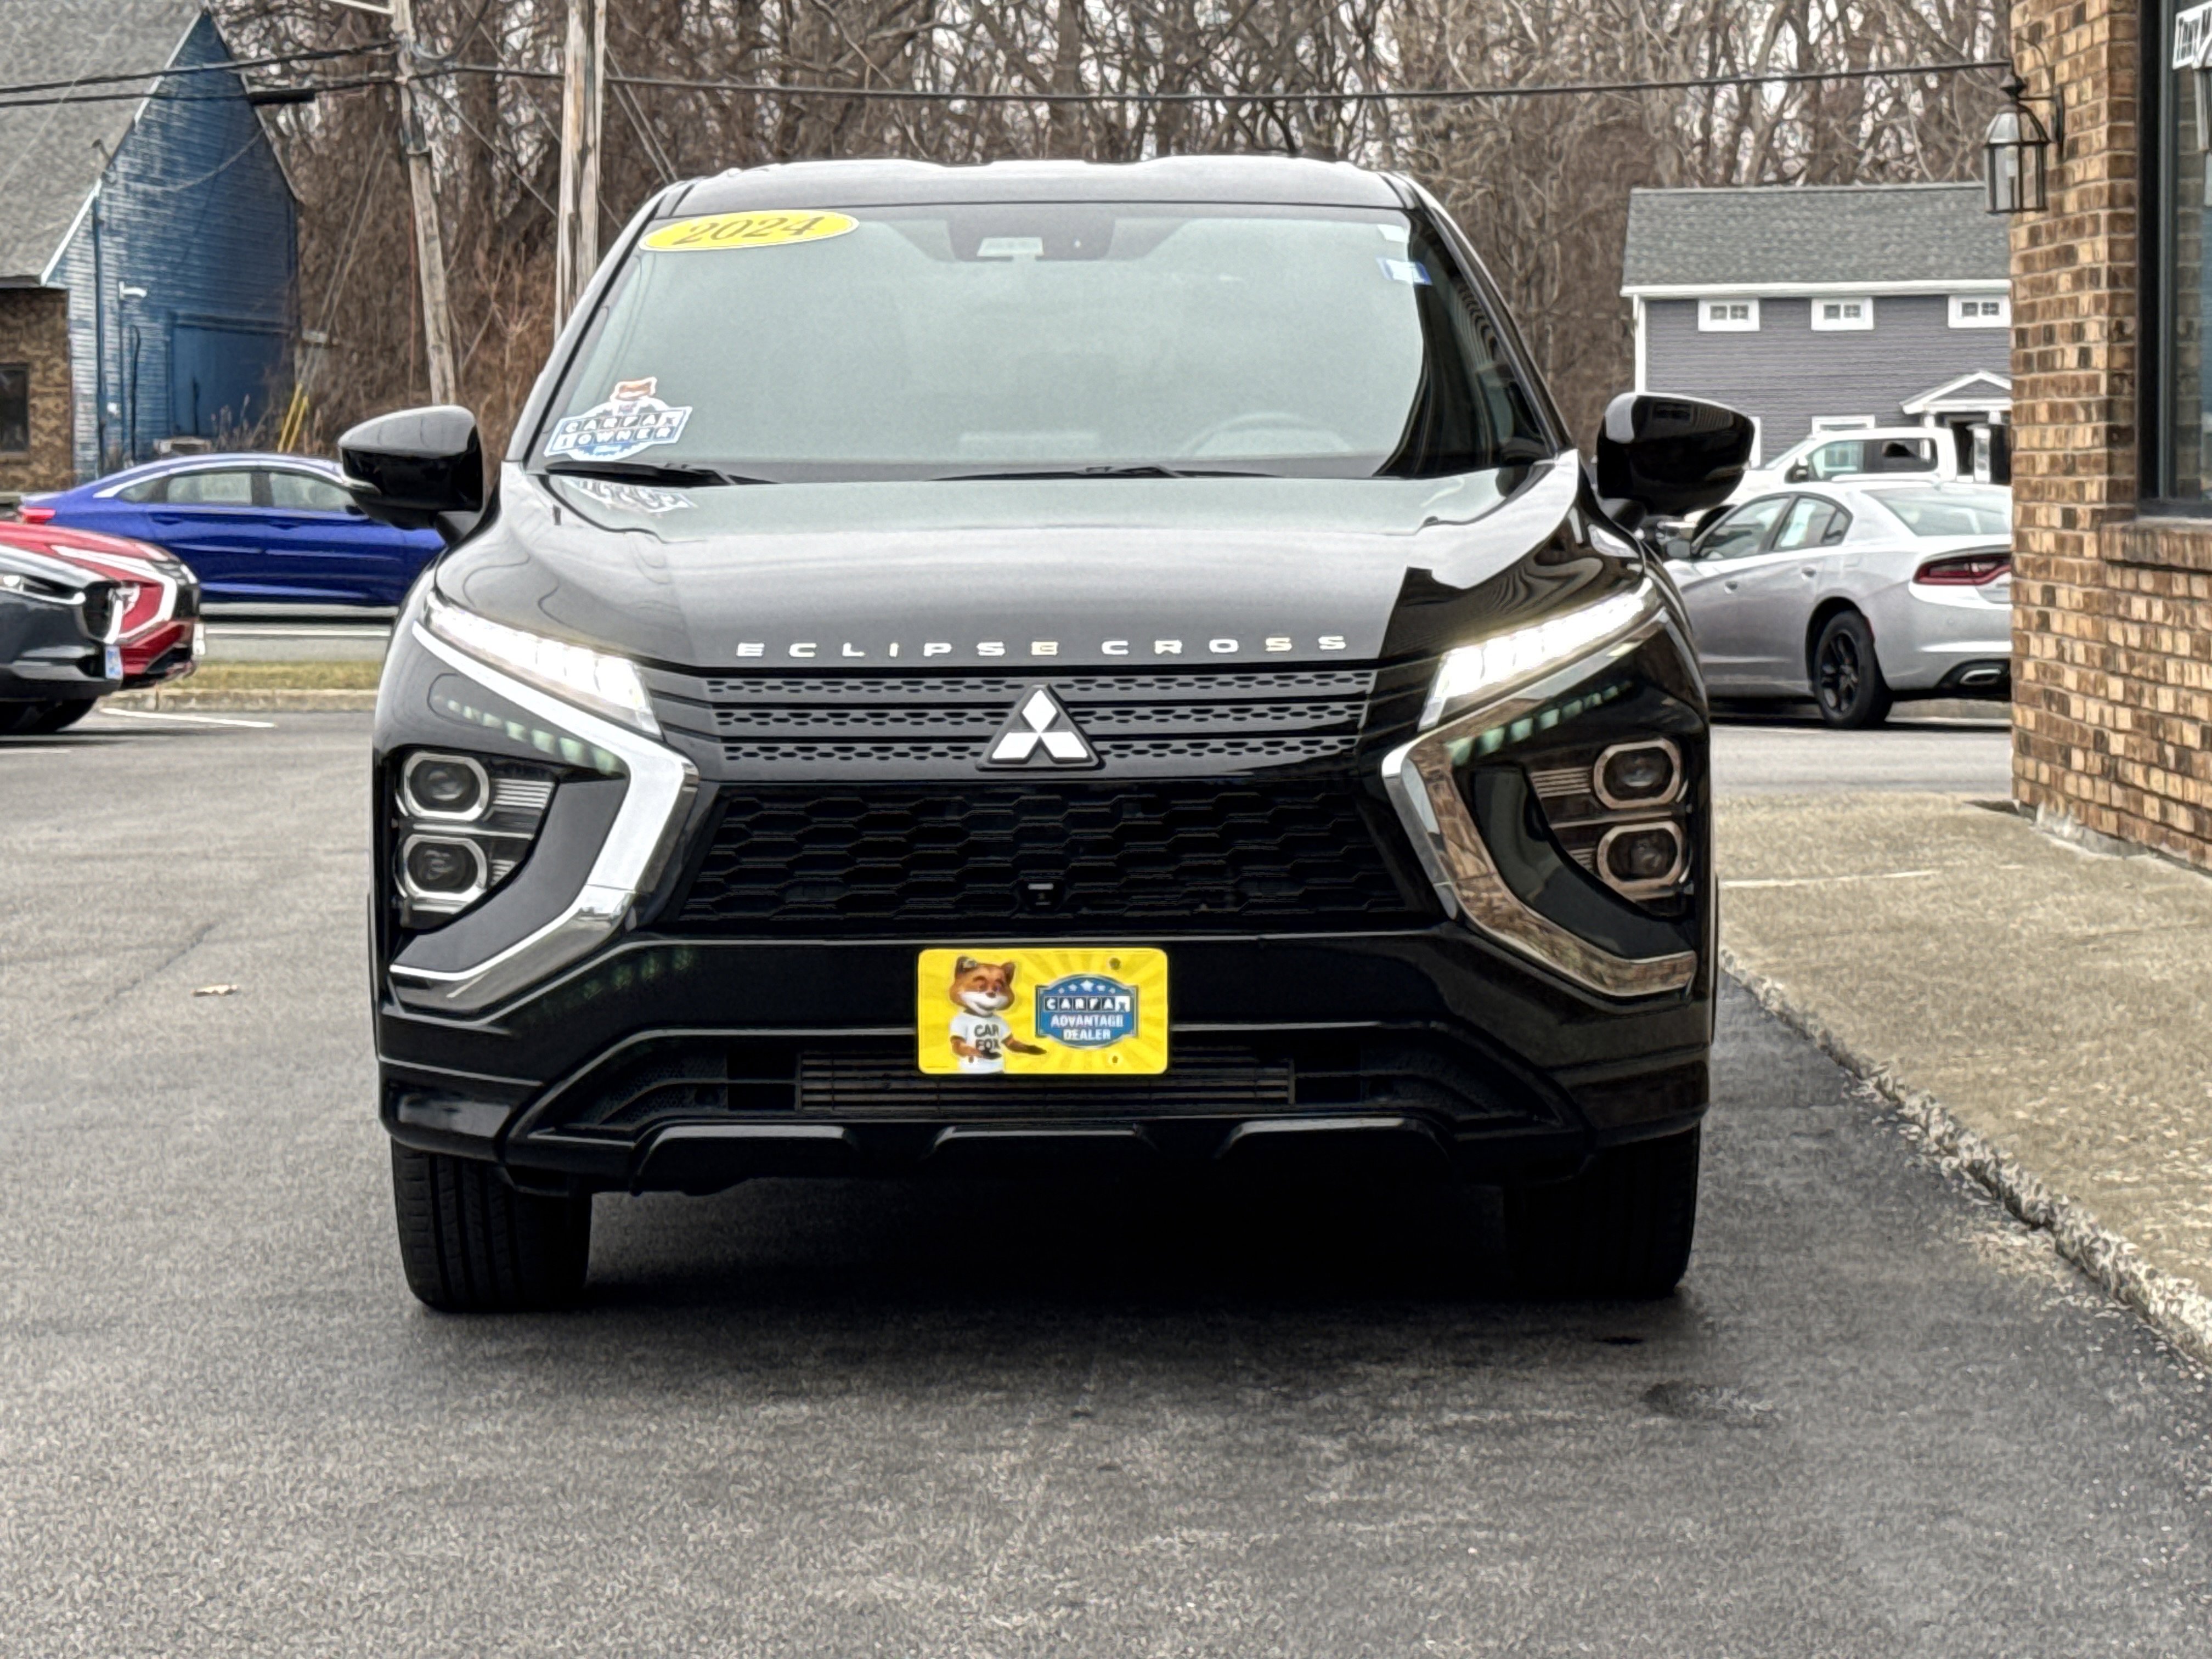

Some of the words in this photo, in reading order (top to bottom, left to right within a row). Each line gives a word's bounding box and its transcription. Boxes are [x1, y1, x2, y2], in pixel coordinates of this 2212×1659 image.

[672, 216, 825, 245] 2024
[578, 427, 672, 444] OWNER
[736, 641, 1059, 658] ECLIPSE
[1101, 635, 1347, 655] CROSS
[1046, 997, 1128, 1011] CARFAX
[1050, 1014, 1124, 1028] ADVANTAGE
[974, 1024, 999, 1038] CAR
[1062, 1028, 1111, 1041] DEALER
[975, 1038, 1001, 1052] FOX
